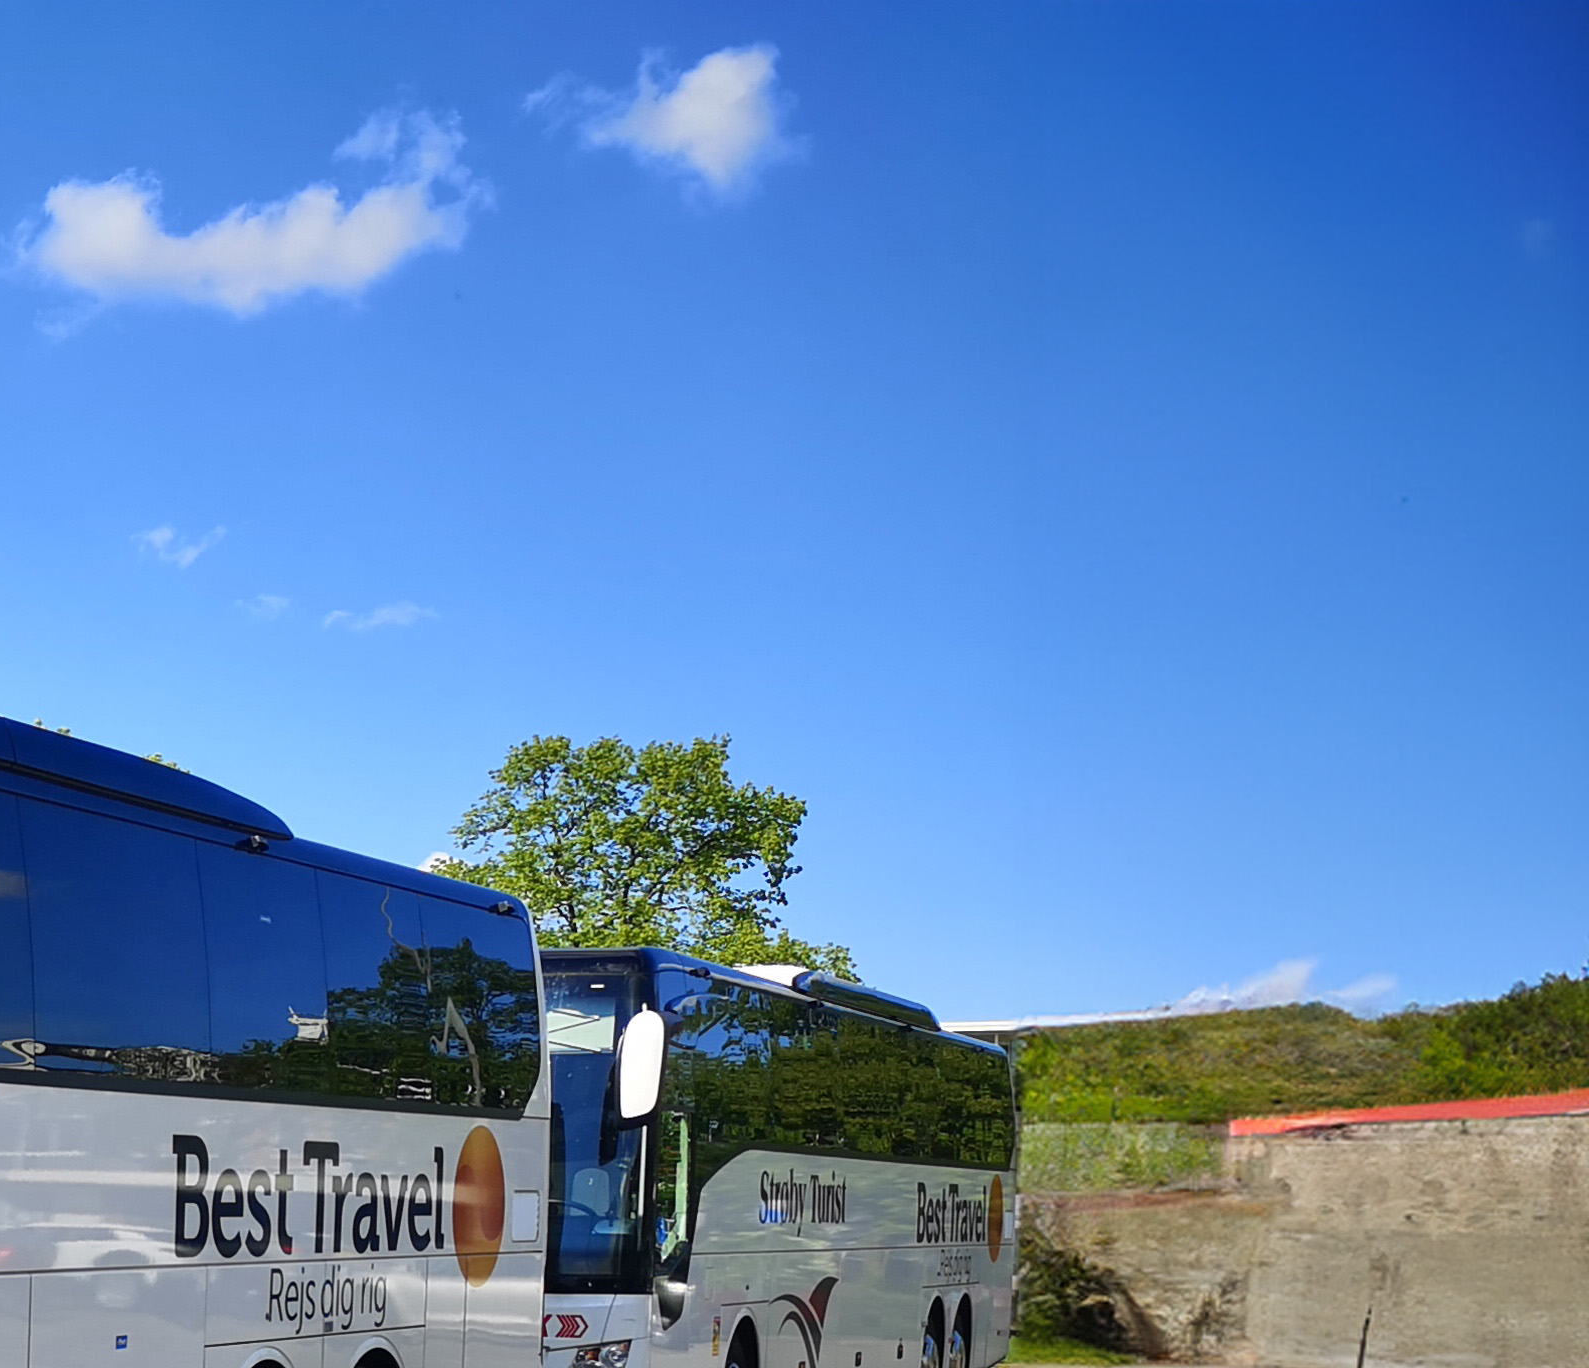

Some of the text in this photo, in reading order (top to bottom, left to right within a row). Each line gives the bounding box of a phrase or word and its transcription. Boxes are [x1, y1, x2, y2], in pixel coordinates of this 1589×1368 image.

[172, 1134, 445, 1258] Best Travel
[810, 1170, 846, 1224] Turist
[916, 1182, 986, 1243] Best Travel
[268, 1263, 387, 1335] Rejs dig rig
